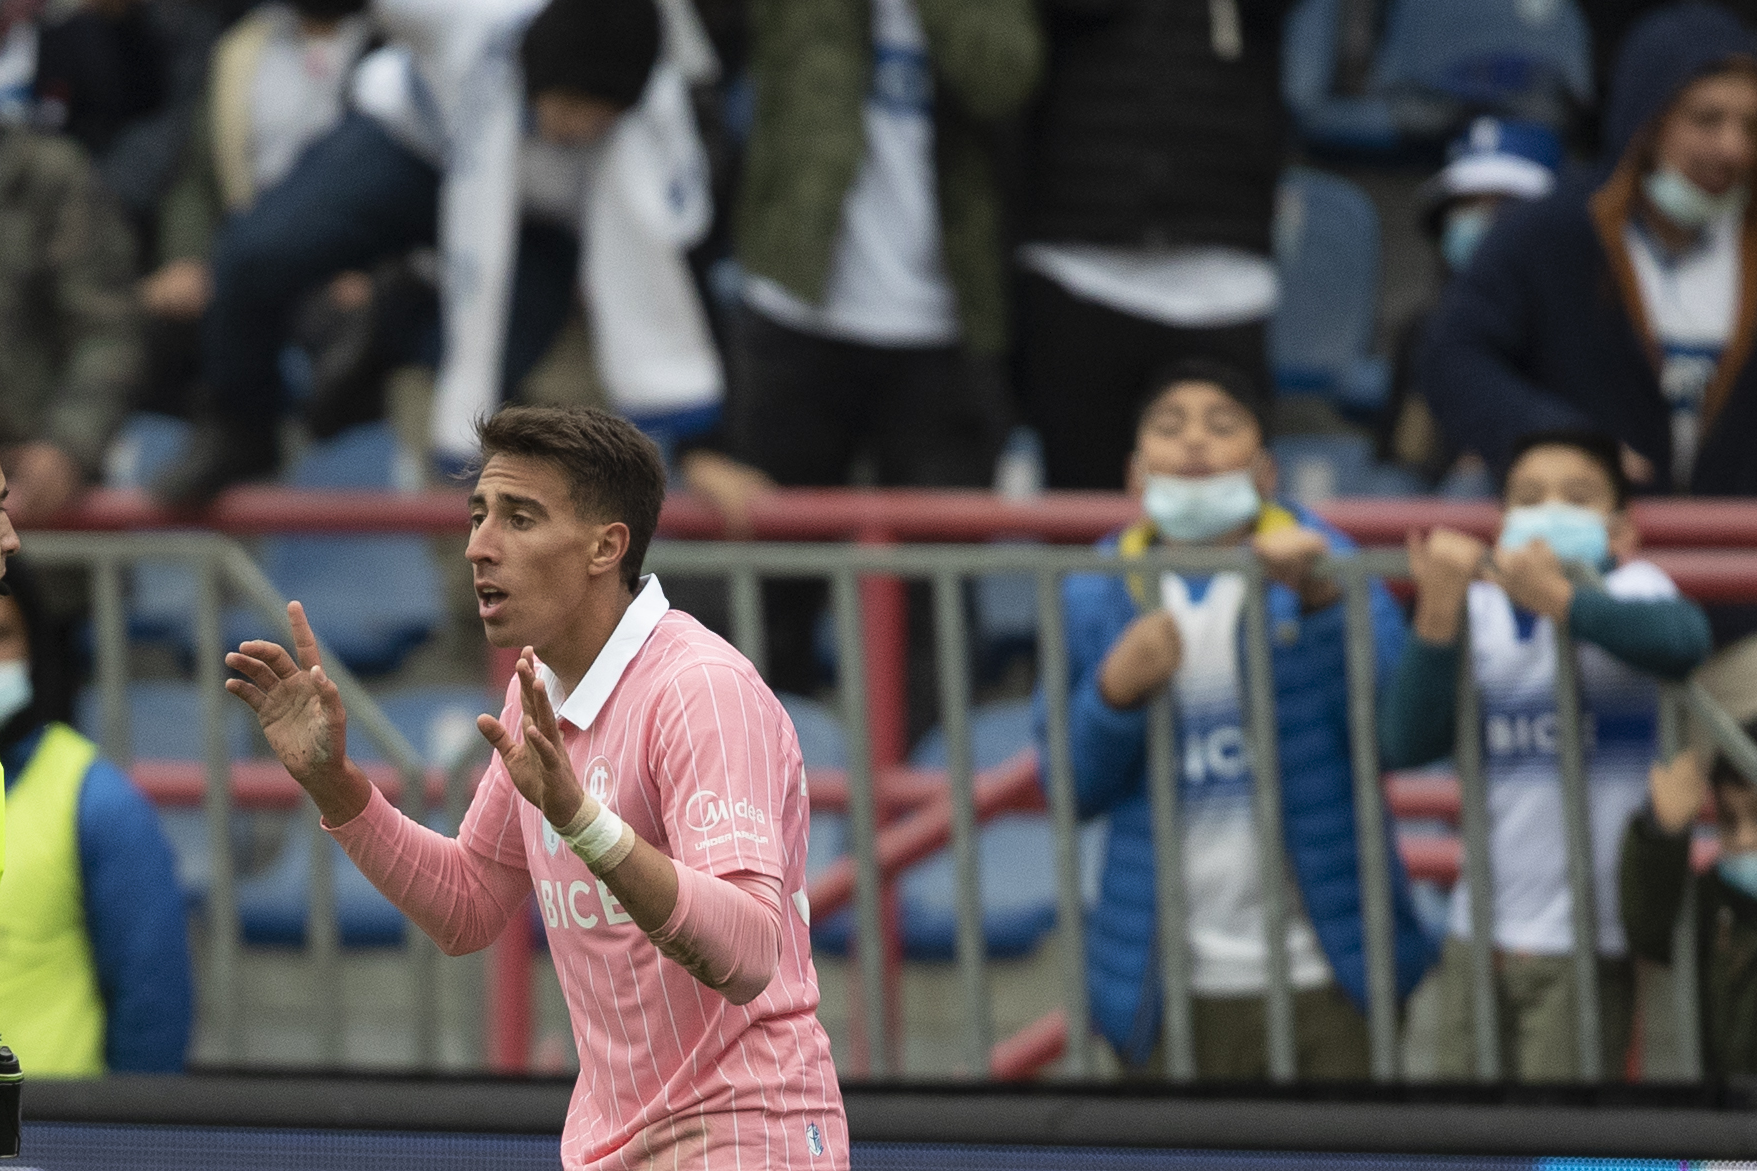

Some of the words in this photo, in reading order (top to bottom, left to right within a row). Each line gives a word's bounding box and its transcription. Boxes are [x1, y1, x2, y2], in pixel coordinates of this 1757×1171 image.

[1487, 711, 1589, 755] BIC
[693, 793, 766, 829] Midea
[695, 832, 733, 850] UNDER
[734, 830, 769, 844] ARMOUR
